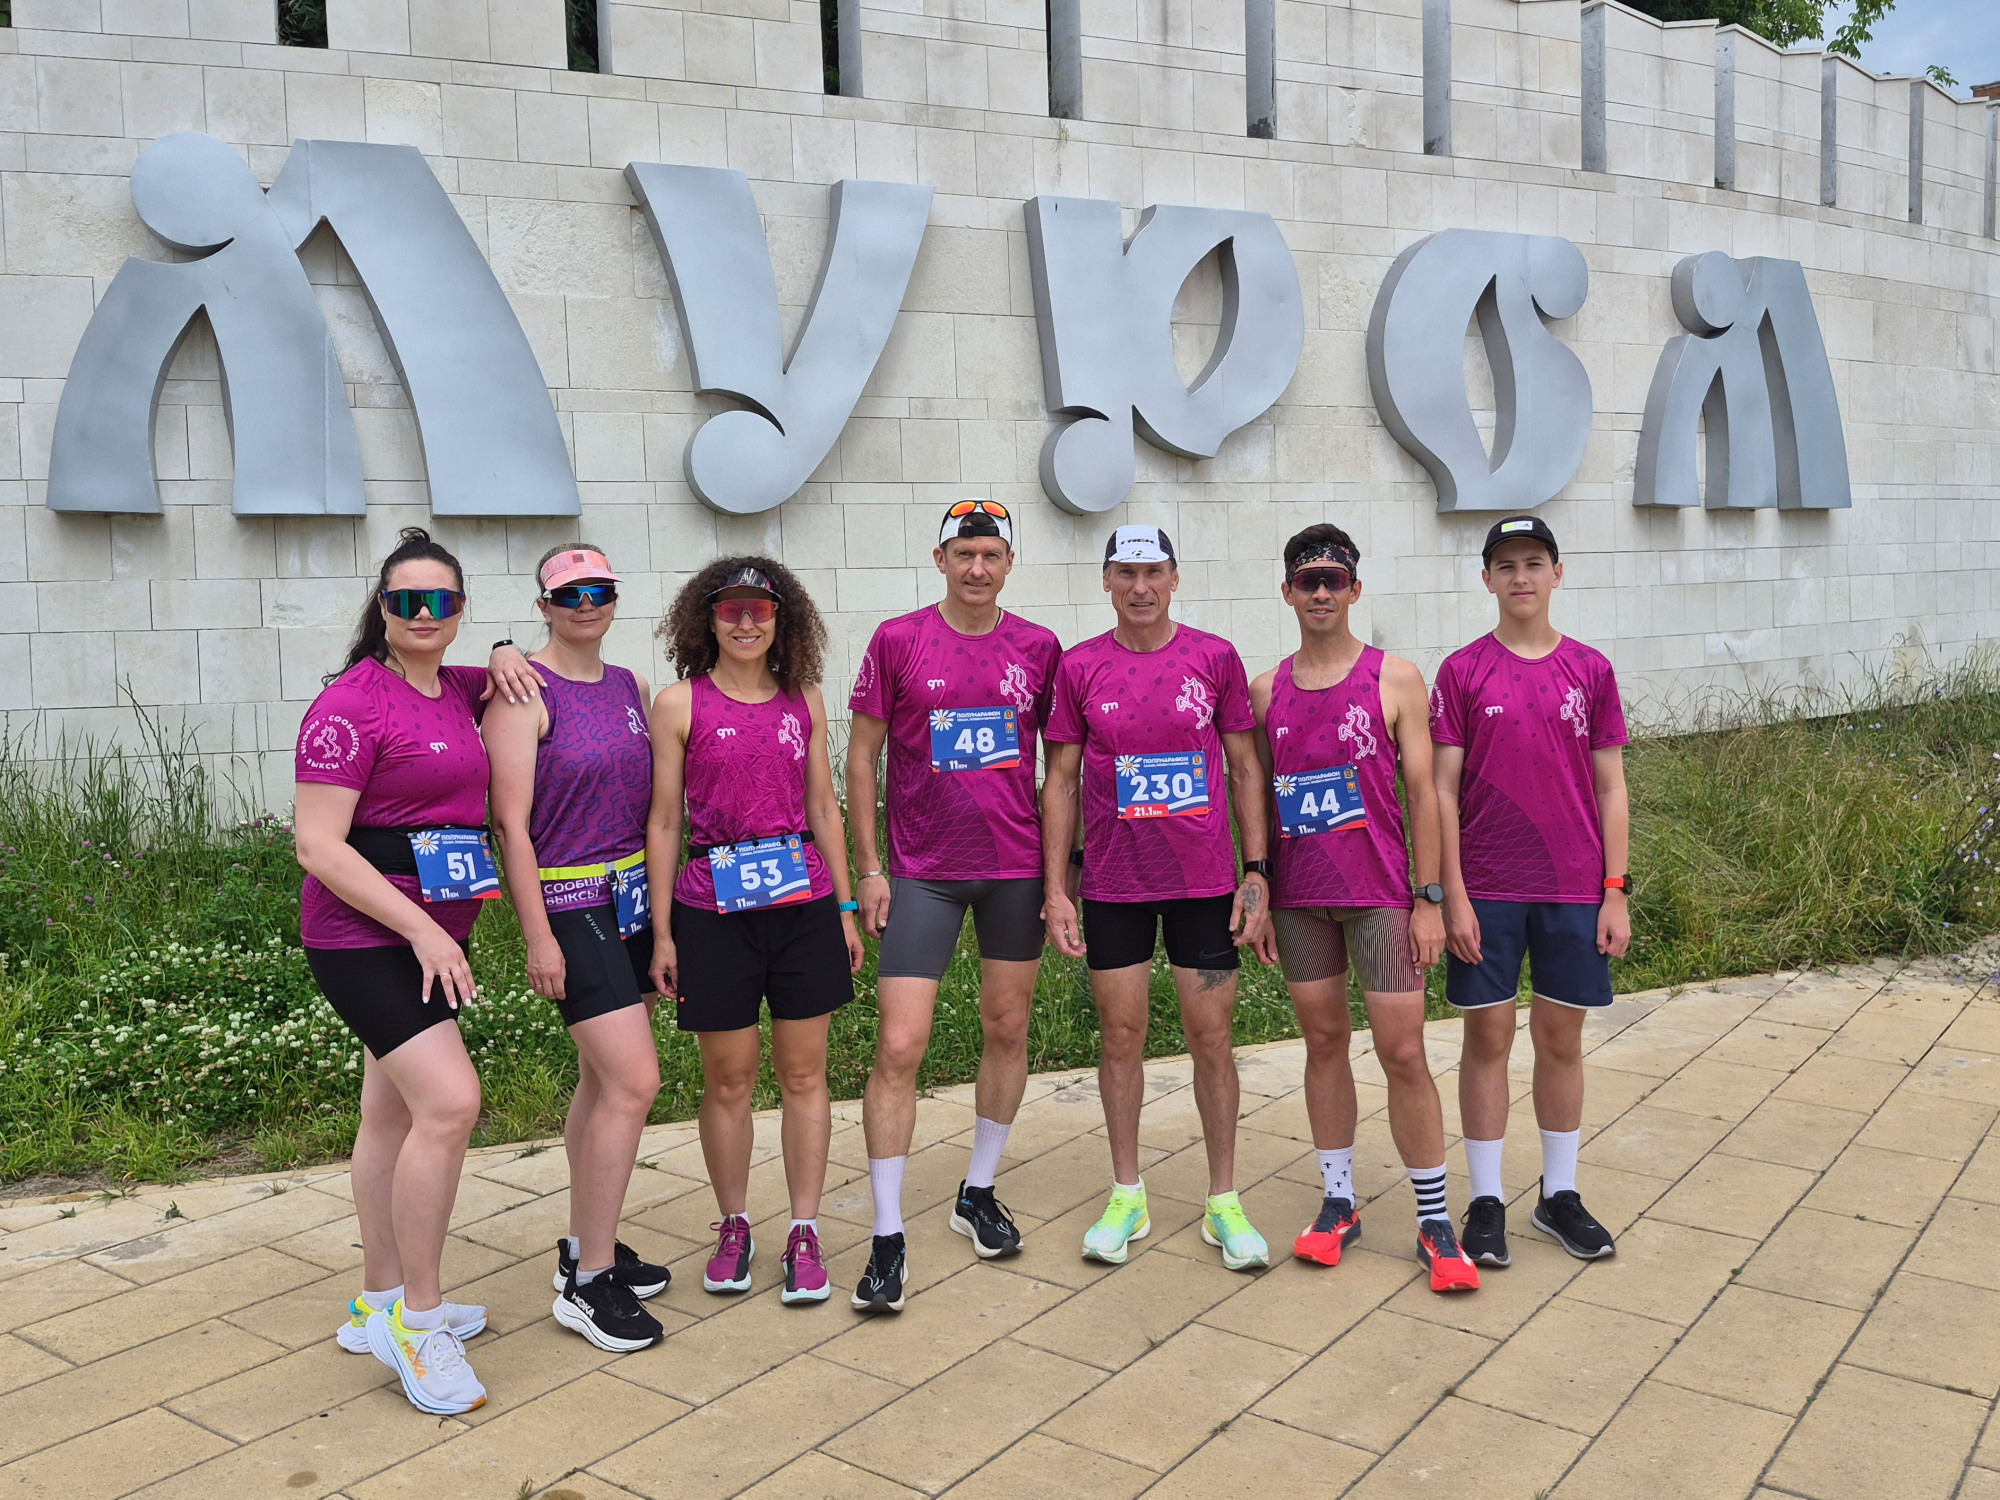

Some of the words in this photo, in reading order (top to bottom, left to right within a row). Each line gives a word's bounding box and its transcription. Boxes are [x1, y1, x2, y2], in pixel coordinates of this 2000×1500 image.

[301, 720, 320, 754] БЕГОВОЕ
[328, 715, 360, 761] СООБЩЕСТВО
[954, 727, 995, 754] 48
[306, 758, 340, 770] ВЫКСЫ
[1130, 772, 1193, 801] 230
[1300, 788, 1341, 817] 44
[738, 841, 786, 853] ПОЛУМАРАФО
[446, 852, 477, 881] 51
[739, 859, 783, 890] 53
[546, 889, 599, 906] ВЫКСЫ
[585, 913, 606, 941] BIVIUM
[571, 1291, 595, 1319] HOKA
[401, 1340, 427, 1380] HOKA
